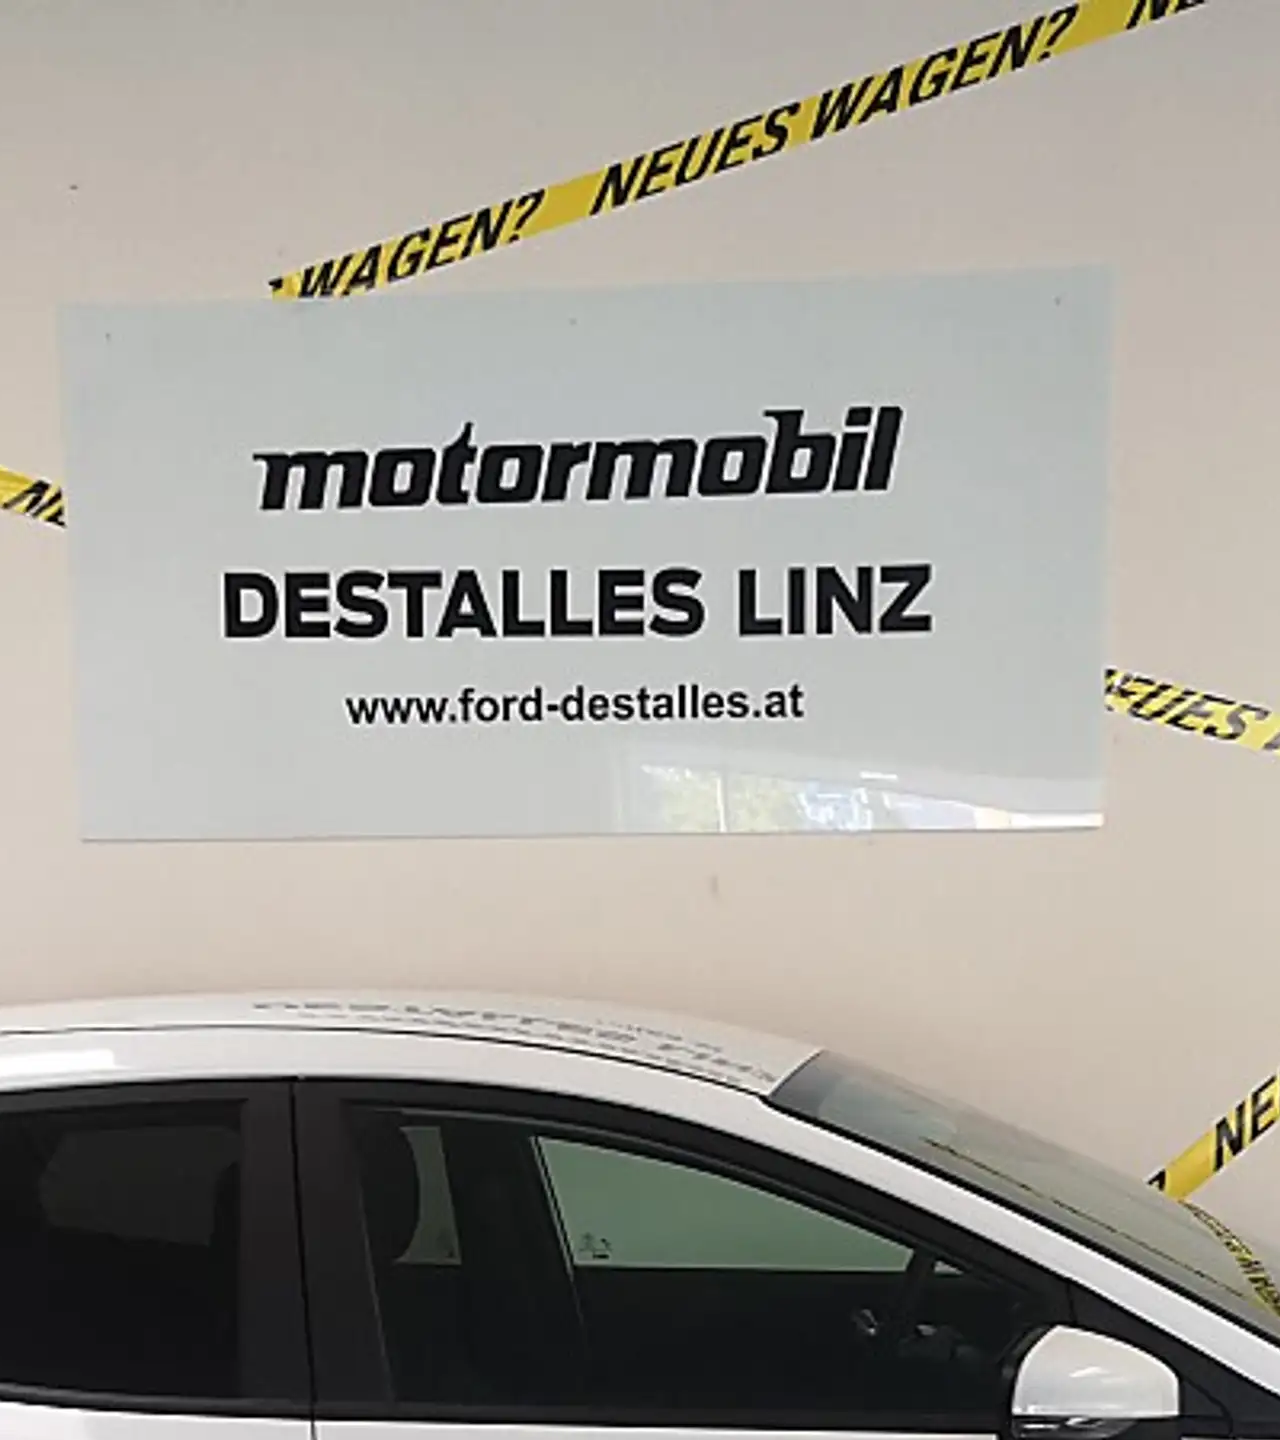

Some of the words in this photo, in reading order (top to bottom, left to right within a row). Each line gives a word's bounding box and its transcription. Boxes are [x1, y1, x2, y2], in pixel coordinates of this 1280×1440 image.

[588, 102, 800, 217] NEUES
[808, 5, 1078, 140] WAGEN?
[298, 190, 545, 300] WAGEN?
[253, 406, 903, 511] motormobil
[223, 568, 705, 638] DESTALLES
[738, 565, 932, 635] LINZ
[346, 684, 803, 726] www.ford-destalles.at
